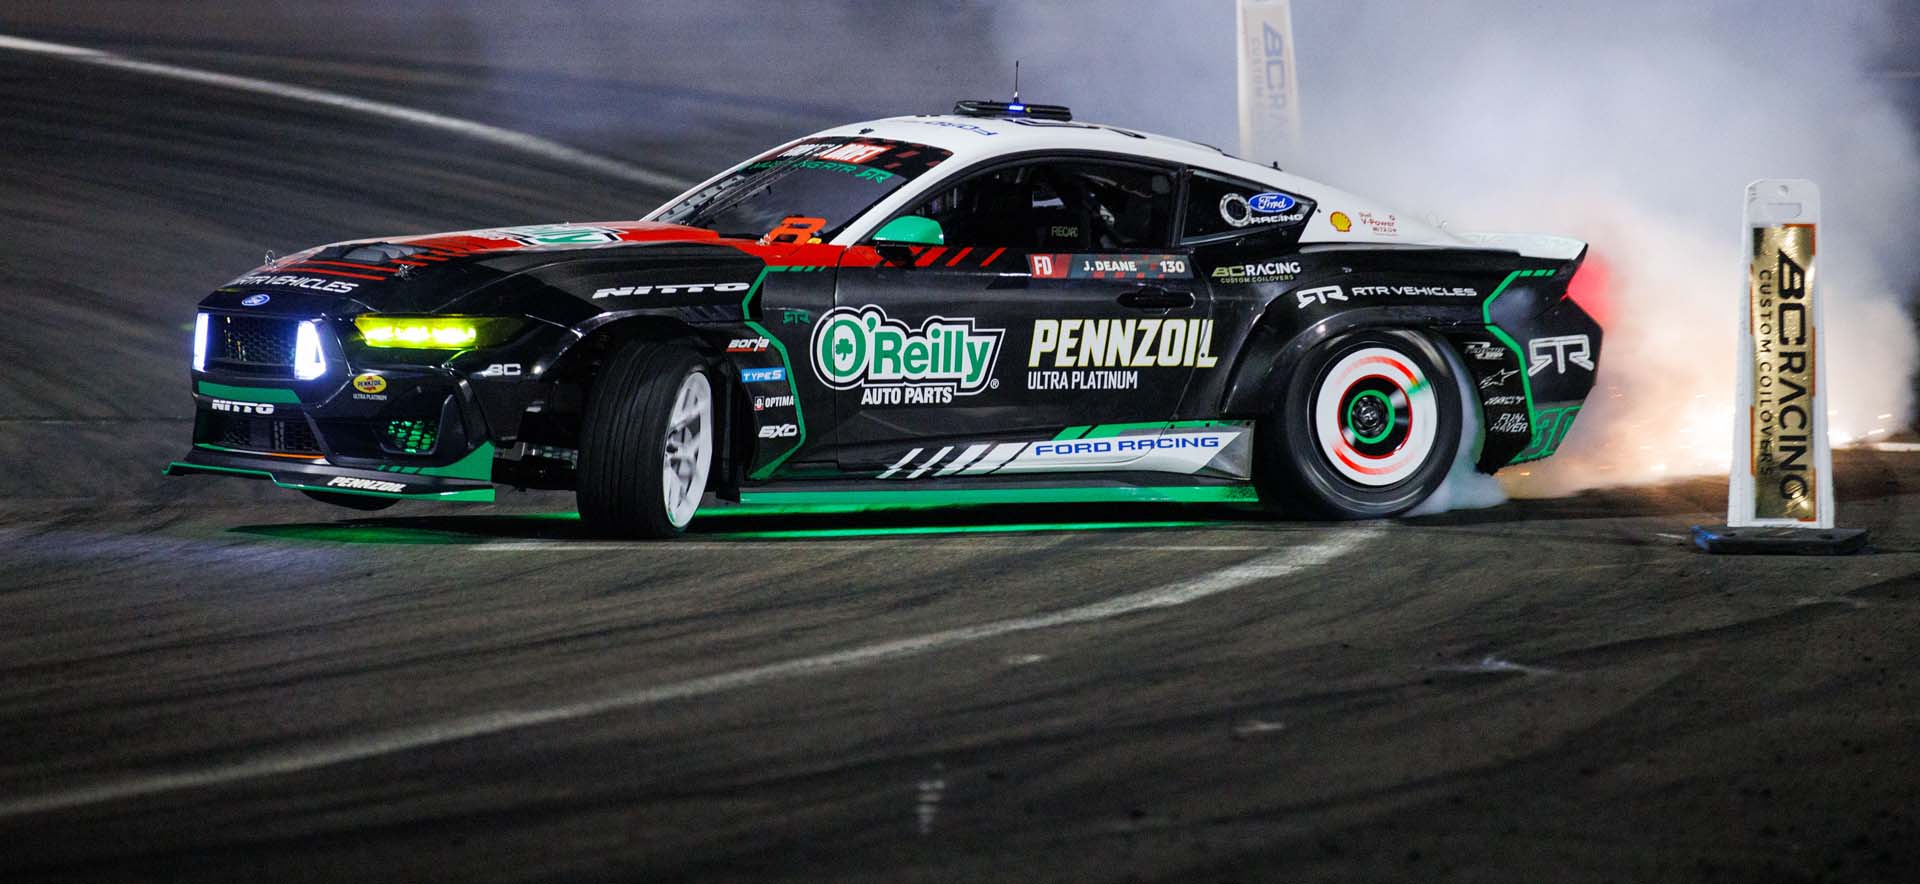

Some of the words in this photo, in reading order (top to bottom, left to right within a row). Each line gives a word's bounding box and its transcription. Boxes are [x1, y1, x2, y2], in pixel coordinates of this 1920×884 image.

[1257, 195, 1287, 209] Ford
[1251, 213, 1304, 224] RACING
[1033, 255, 1053, 275] FD
[1095, 261, 1137, 272] DEANE
[1160, 261, 1185, 273] 130
[1220, 276, 1251, 284] CUSTOM
[1252, 274, 1294, 282] COILOVERS
[592, 283, 750, 299] NITTO
[1352, 286, 1390, 297] RTR
[1391, 286, 1477, 297] VEHICLES
[1759, 269, 1773, 353] CUSTOM
[1028, 319, 1218, 368] PENNZOIL
[1028, 371, 1068, 390] ULTRA
[1071, 370, 1138, 390] PLATINUM
[765, 396, 794, 408] OPTIMA
[861, 388, 901, 405] AUTO
[904, 387, 952, 404] PARTS
[211, 399, 275, 415] NITTO
[1760, 361, 1774, 476] COILOVERS
[1035, 443, 1112, 456] FORD
[1118, 437, 1219, 452] RACING
[327, 476, 407, 492] PENNZOIL
